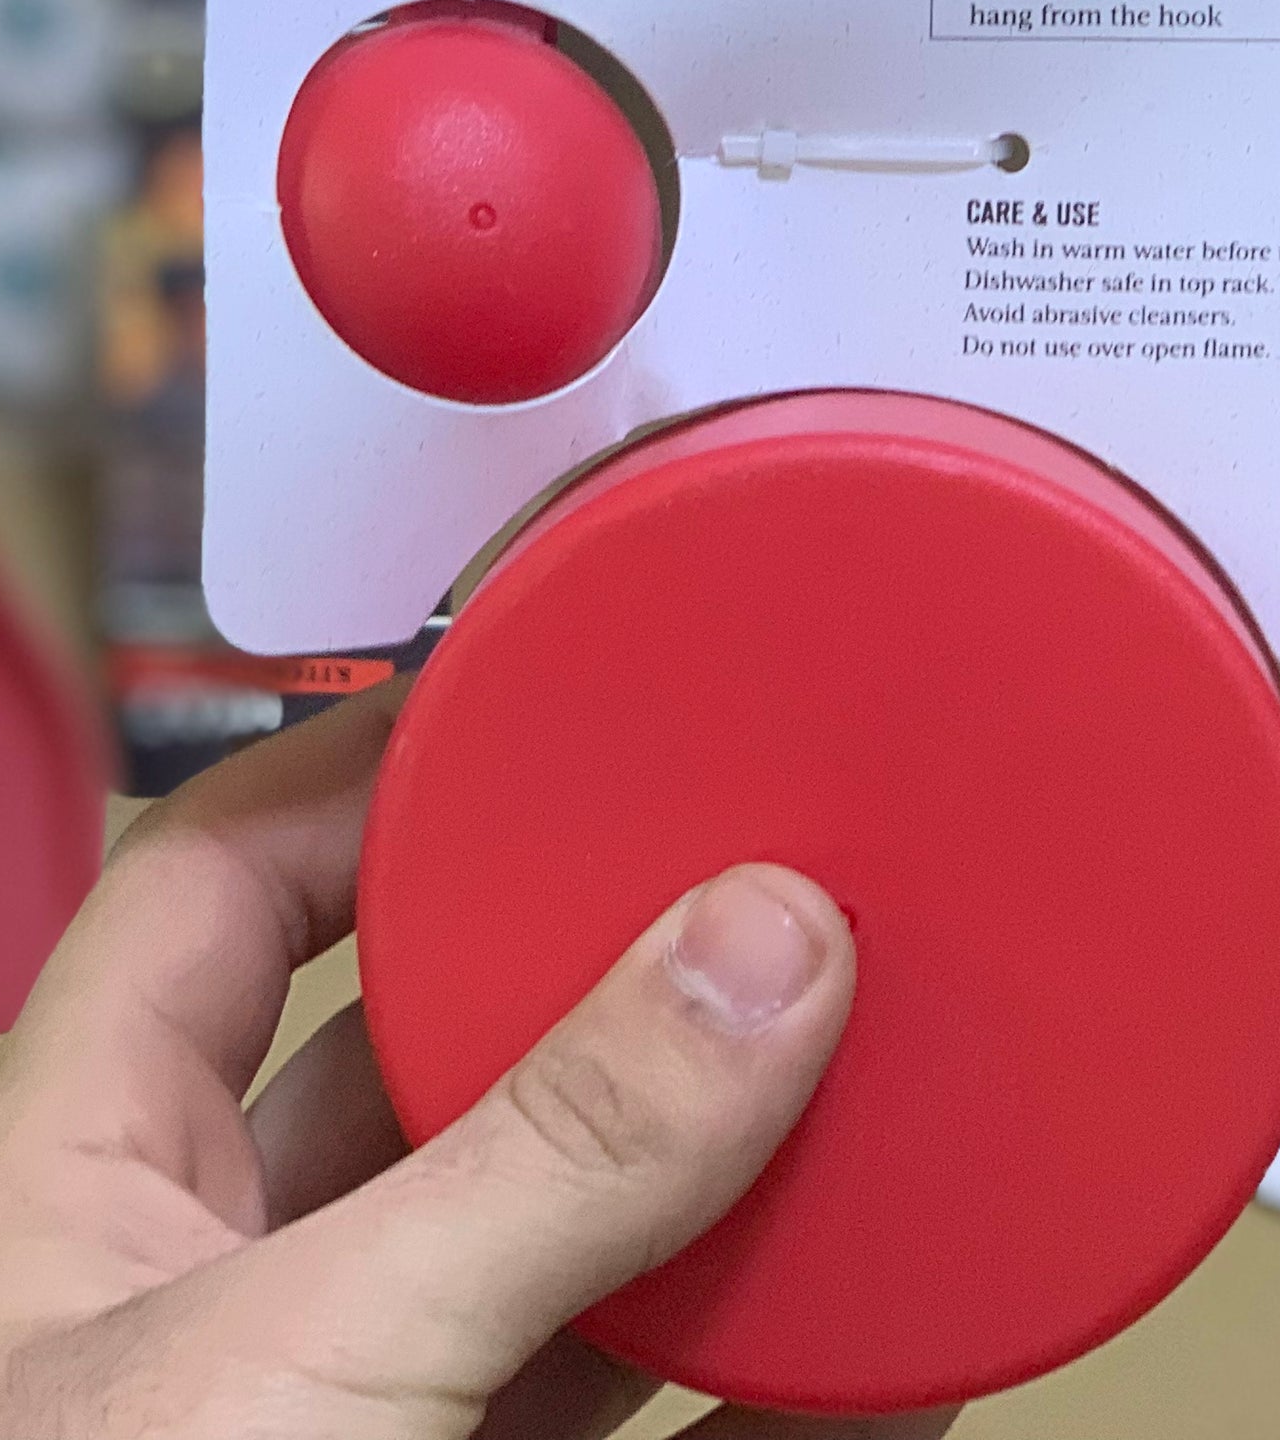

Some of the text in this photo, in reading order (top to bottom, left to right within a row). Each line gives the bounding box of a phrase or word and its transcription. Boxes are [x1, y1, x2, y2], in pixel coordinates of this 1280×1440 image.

[970, 3, 1222, 31] hang from the hook
[966, 199, 1100, 227] CARE & USE
[967, 237, 1025, 258] Wash
[1032, 239, 1054, 259] in
[1061, 244, 1125, 260] warm
[1133, 244, 1195, 260] water
[1202, 241, 1271, 261] before
[965, 270, 1274, 298] Dishwasher safe in top rack.
[963, 302, 1235, 326] Avoid abrasive cleansers.
[962, 335, 1269, 363] Do not use over open flame.
